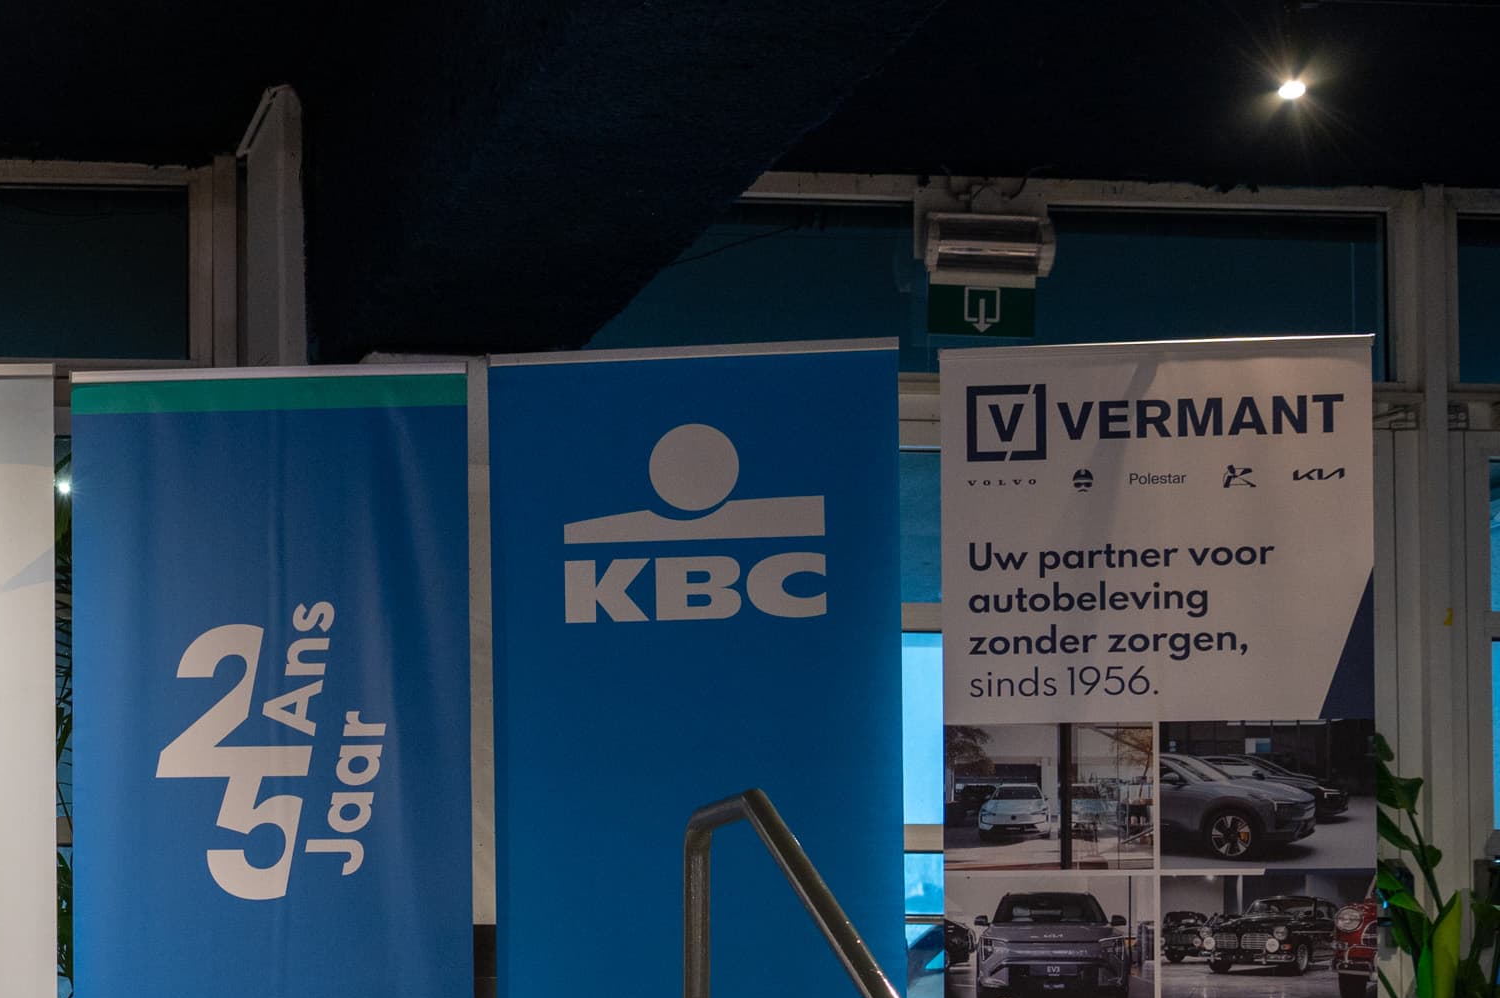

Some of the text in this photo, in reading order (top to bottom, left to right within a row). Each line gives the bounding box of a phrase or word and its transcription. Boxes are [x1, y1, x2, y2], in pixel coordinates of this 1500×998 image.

[1057, 393, 1344, 440] VERMANT
[968, 478, 1037, 486] VOLVO
[1129, 472, 1186, 485] Polestar
[969, 543, 1274, 578] Uw partner voor
[564, 552, 827, 623] KBC
[969, 582, 1209, 617] autobeleving
[969, 625, 1249, 660] zonder zorgen,
[262, 601, 335, 737] Ans
[970, 665, 1159, 697] sinds 1956.
[305, 711, 387, 876] Jaar
